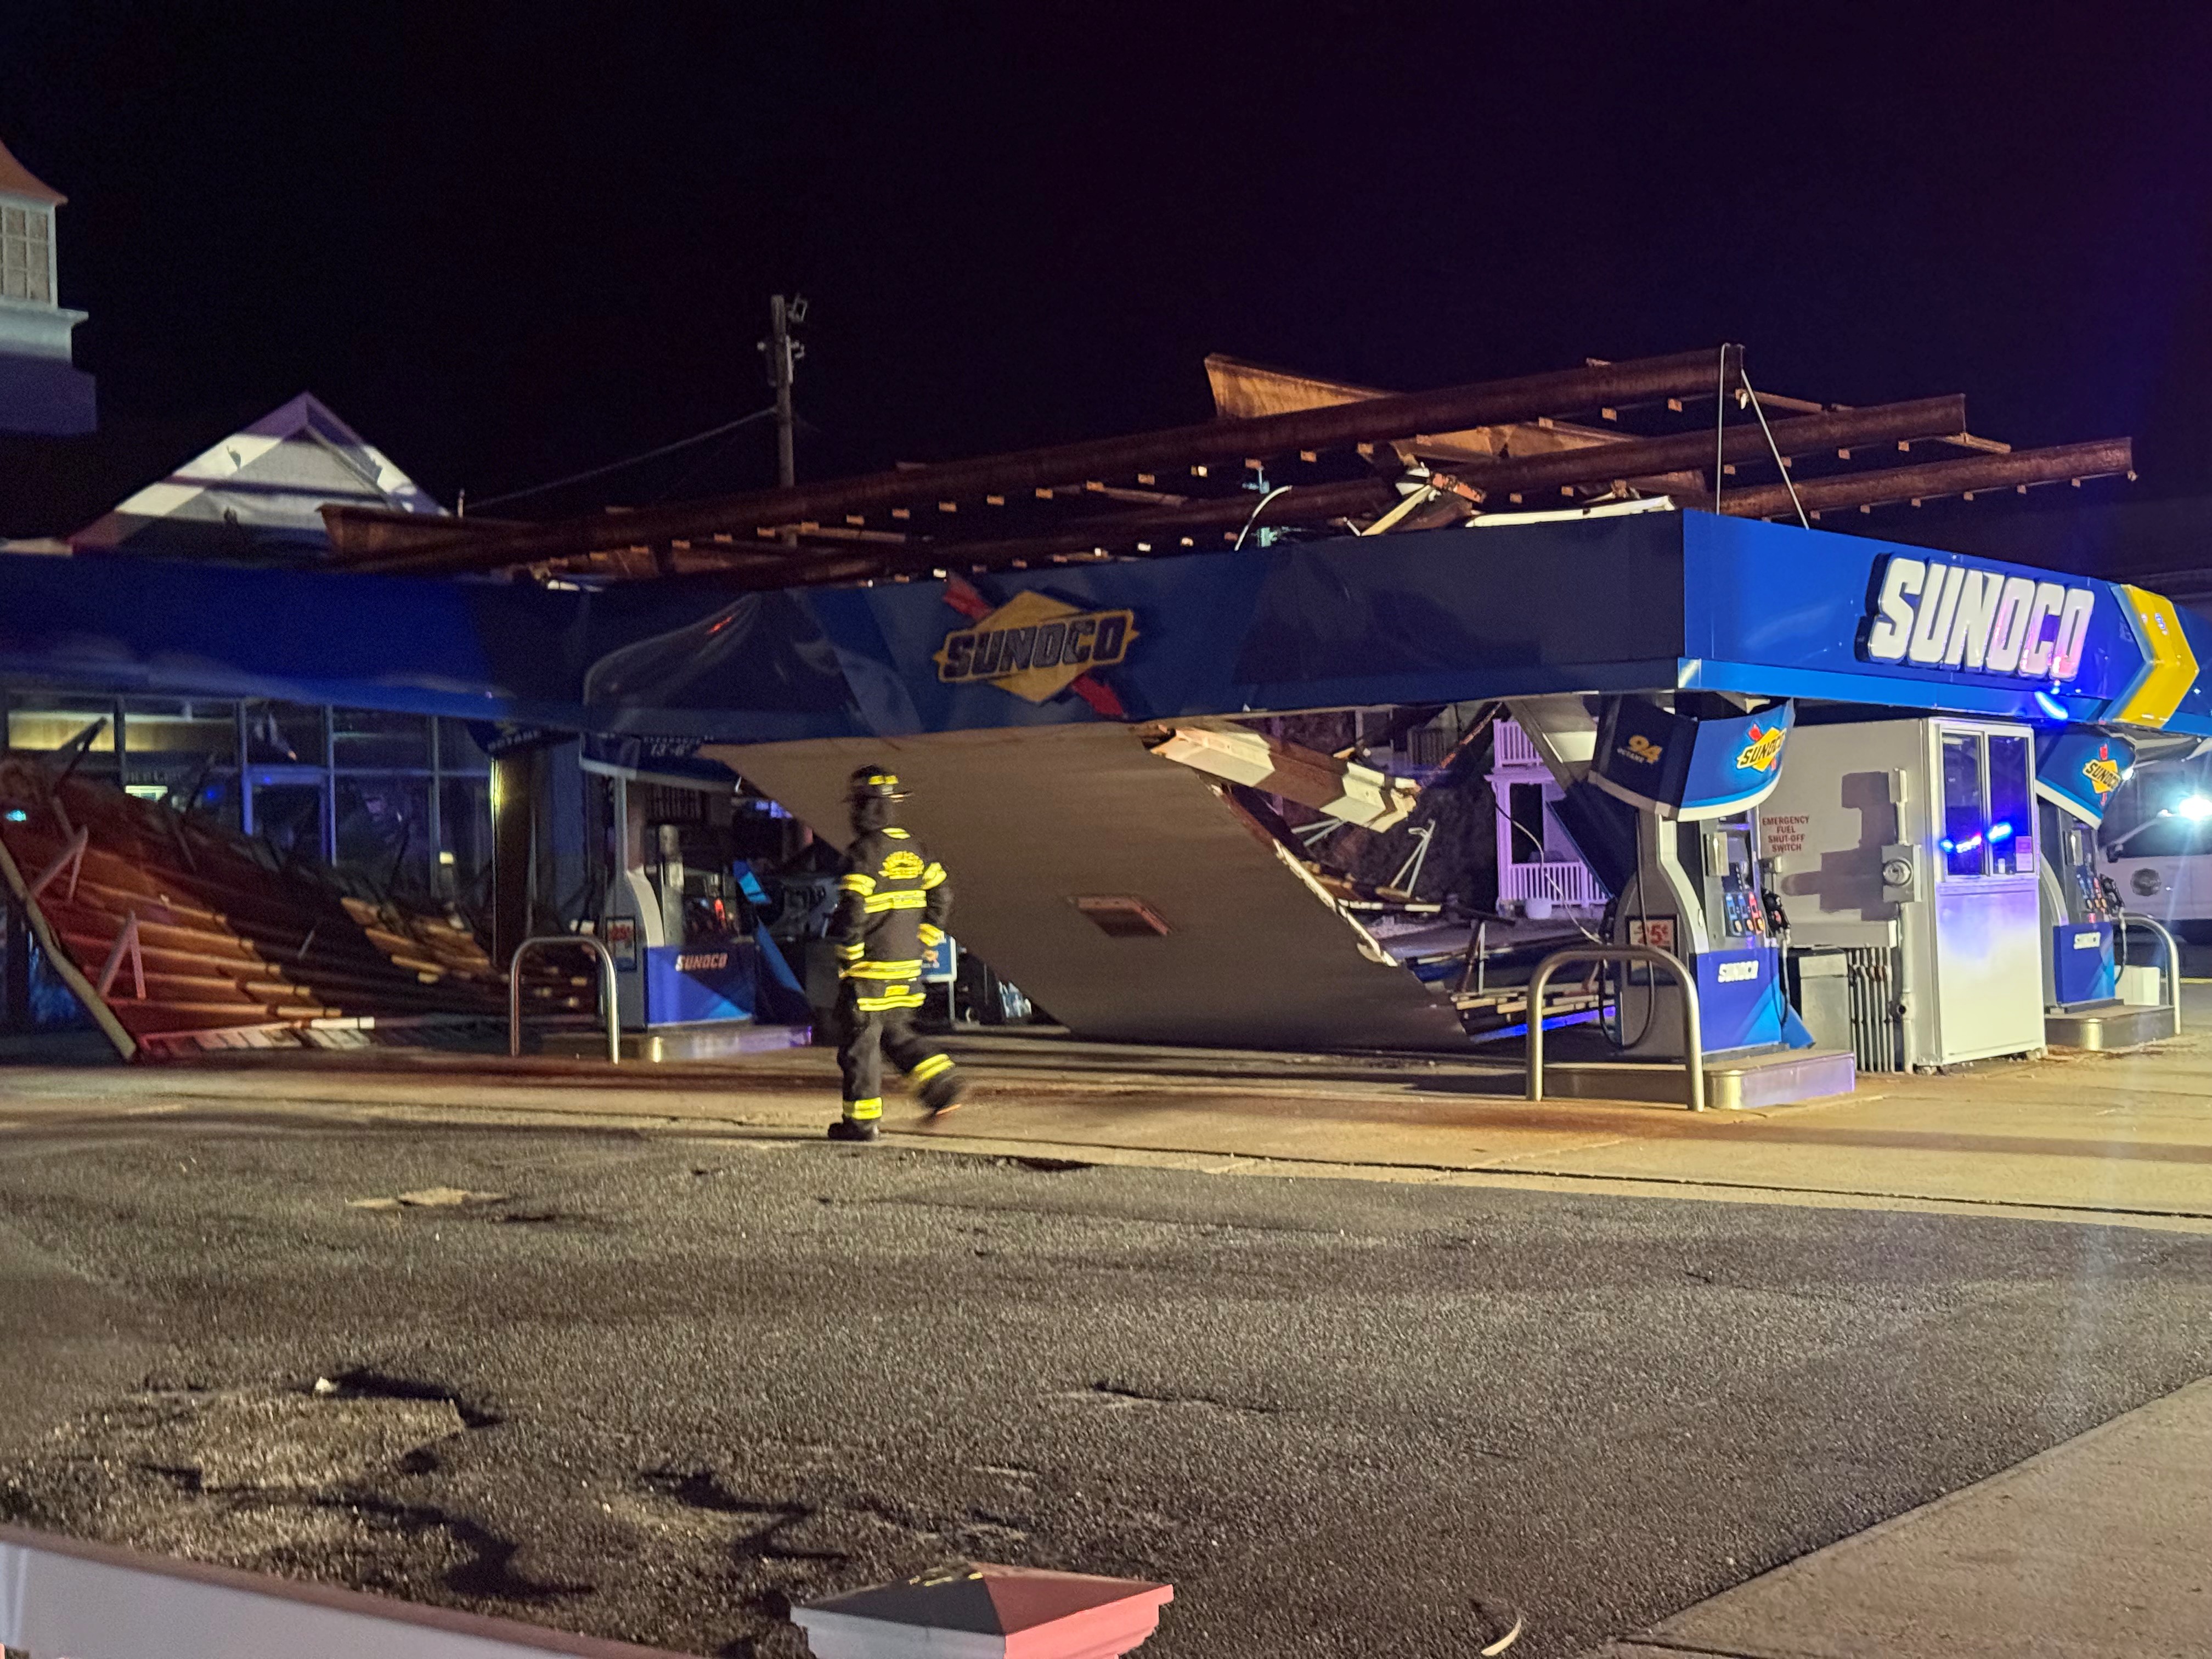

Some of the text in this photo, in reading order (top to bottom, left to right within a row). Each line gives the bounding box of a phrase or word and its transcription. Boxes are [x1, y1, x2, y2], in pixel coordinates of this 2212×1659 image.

[1869, 557, 2095, 681] SUNOCO
[943, 614, 1128, 679] SUNOCO
[1762, 815, 1809, 825] EMERGENCY
[1768, 833, 1805, 843] SHUT-OFF
[1772, 843, 1802, 853] SWITCH
[675, 952, 729, 972] SUNOCO
